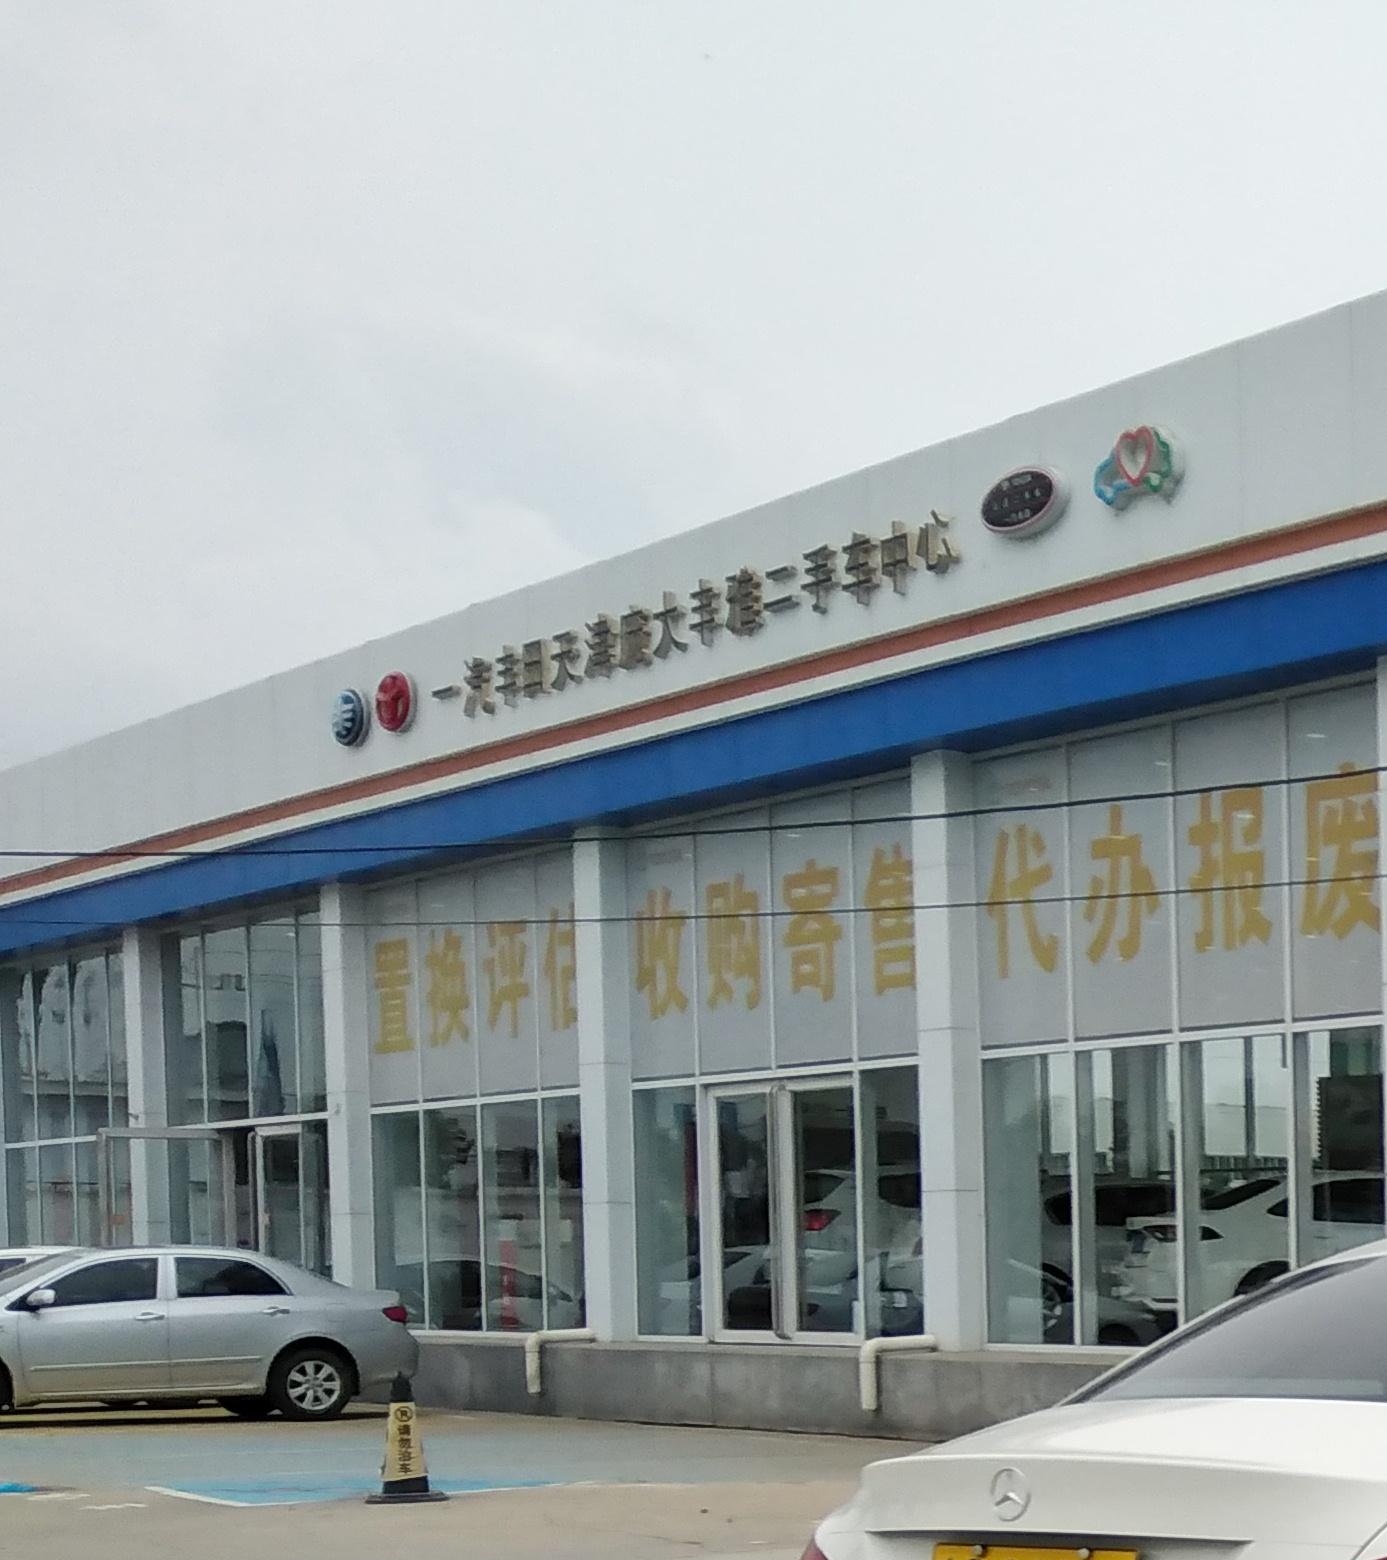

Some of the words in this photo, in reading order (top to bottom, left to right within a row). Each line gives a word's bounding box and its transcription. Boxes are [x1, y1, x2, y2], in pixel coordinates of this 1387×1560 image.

[373, 902, 578, 1054] 置换评估
[635, 843, 917, 1022] 收购寄售
[987, 762, 1381, 979] 代办报废
